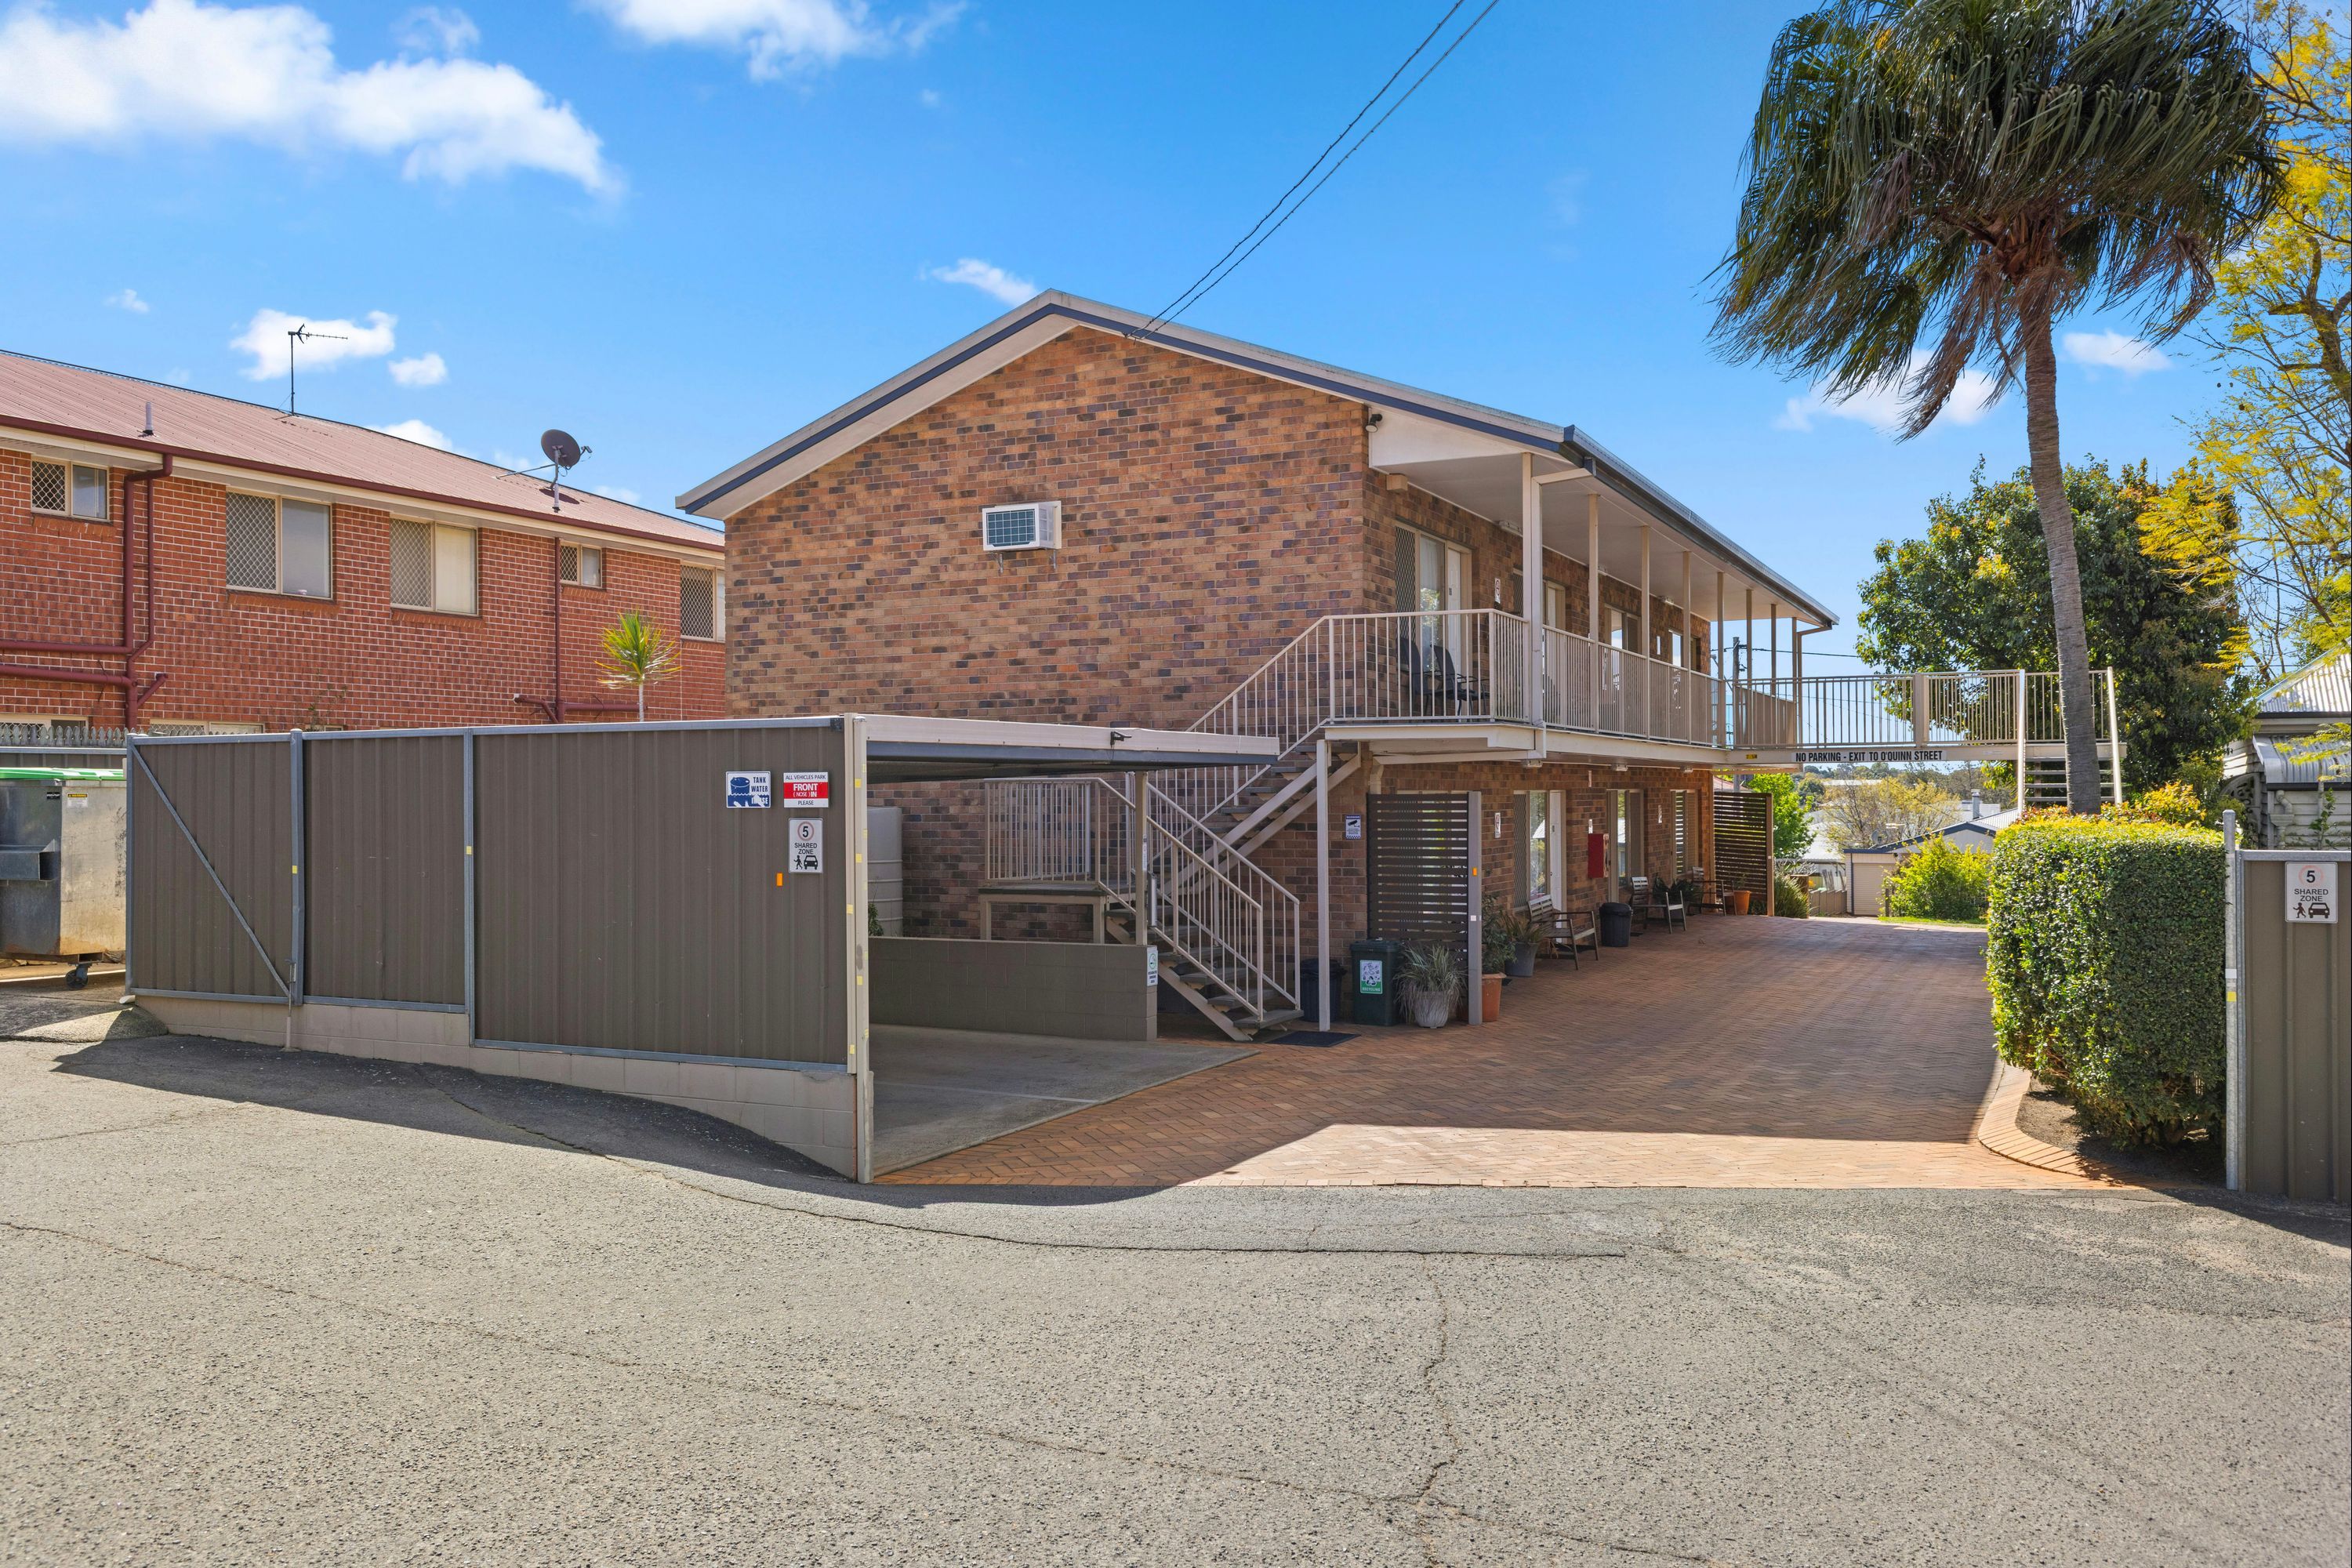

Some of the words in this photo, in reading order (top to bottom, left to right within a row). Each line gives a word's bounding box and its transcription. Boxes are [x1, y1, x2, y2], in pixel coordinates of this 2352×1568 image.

[1796, 753, 1806, 762] NO
[1808, 752, 1841, 762] PARKING
[1849, 752, 1866, 761] EXIT
[1869, 751, 1879, 761] TO
[1881, 751, 1912, 761] O'QUINN
[1914, 750, 1943, 760] STREET
[802, 826, 808, 837] 5
[2307, 870, 2315, 883] 5
